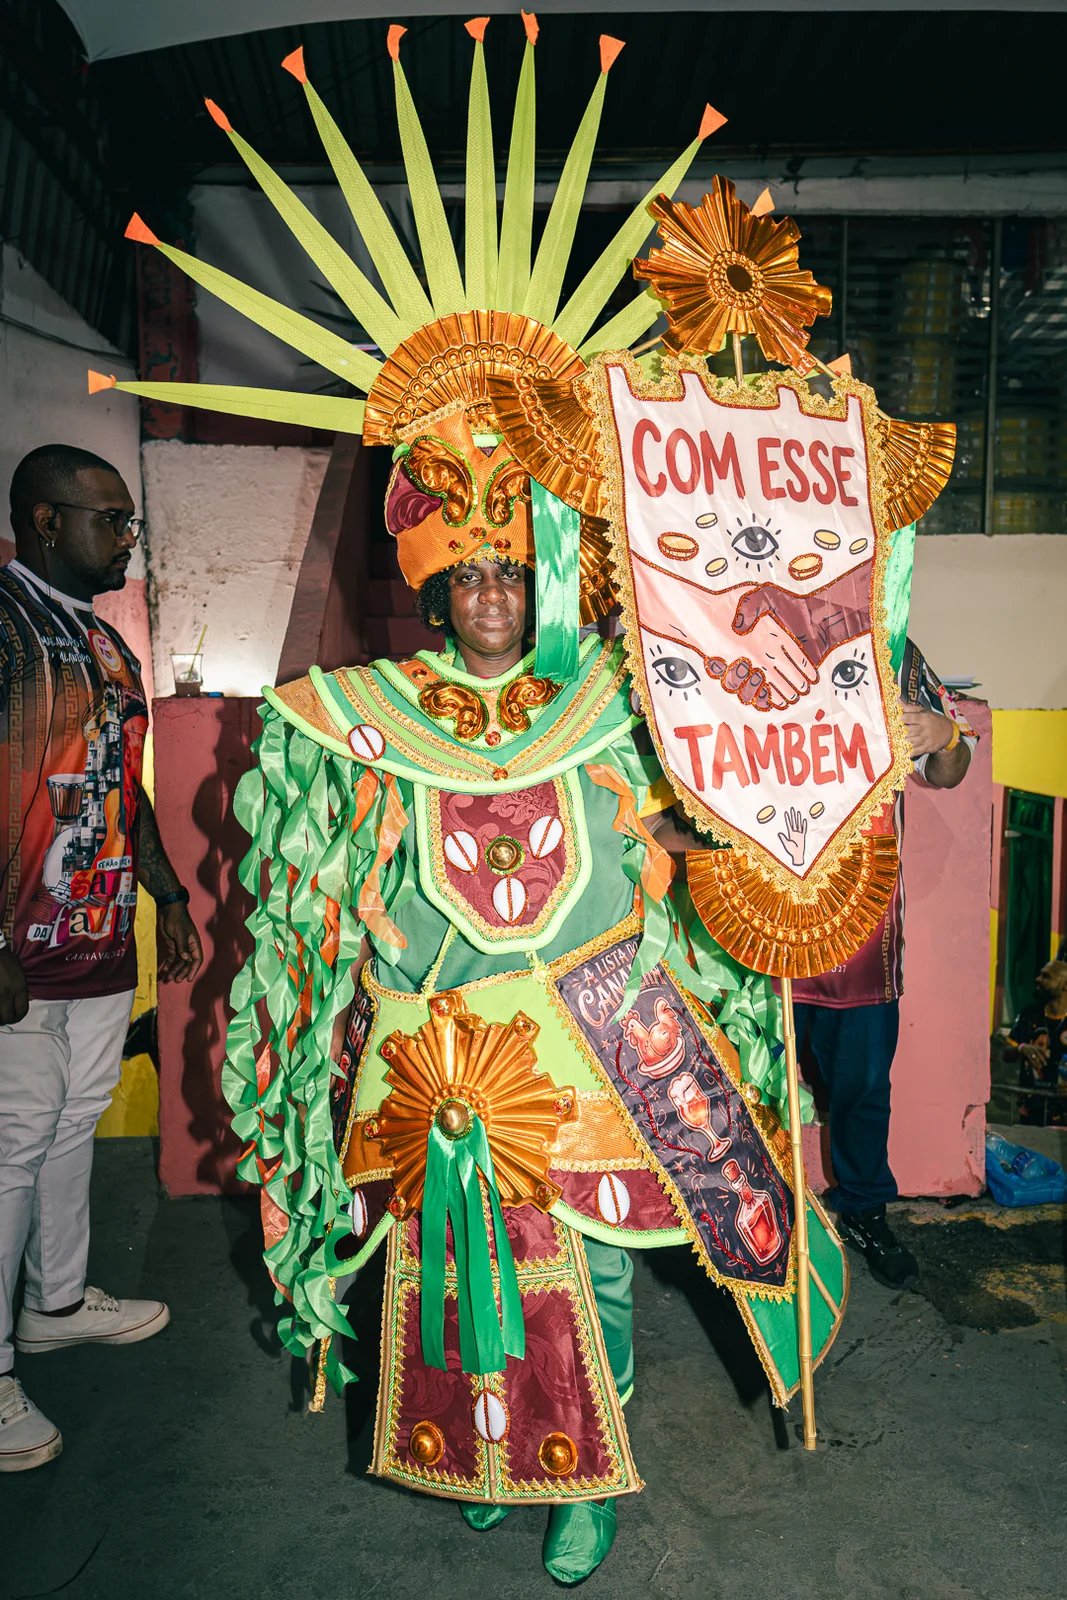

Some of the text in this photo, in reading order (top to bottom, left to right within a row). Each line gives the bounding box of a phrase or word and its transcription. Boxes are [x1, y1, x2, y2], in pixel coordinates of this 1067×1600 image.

[633, 418, 859, 507] COM ESSE
[674, 709, 875, 792] TAMBÉM
[33, 926, 48, 939] DA
[583, 967, 599, 988] A
[595, 947, 629, 977] LISTA
